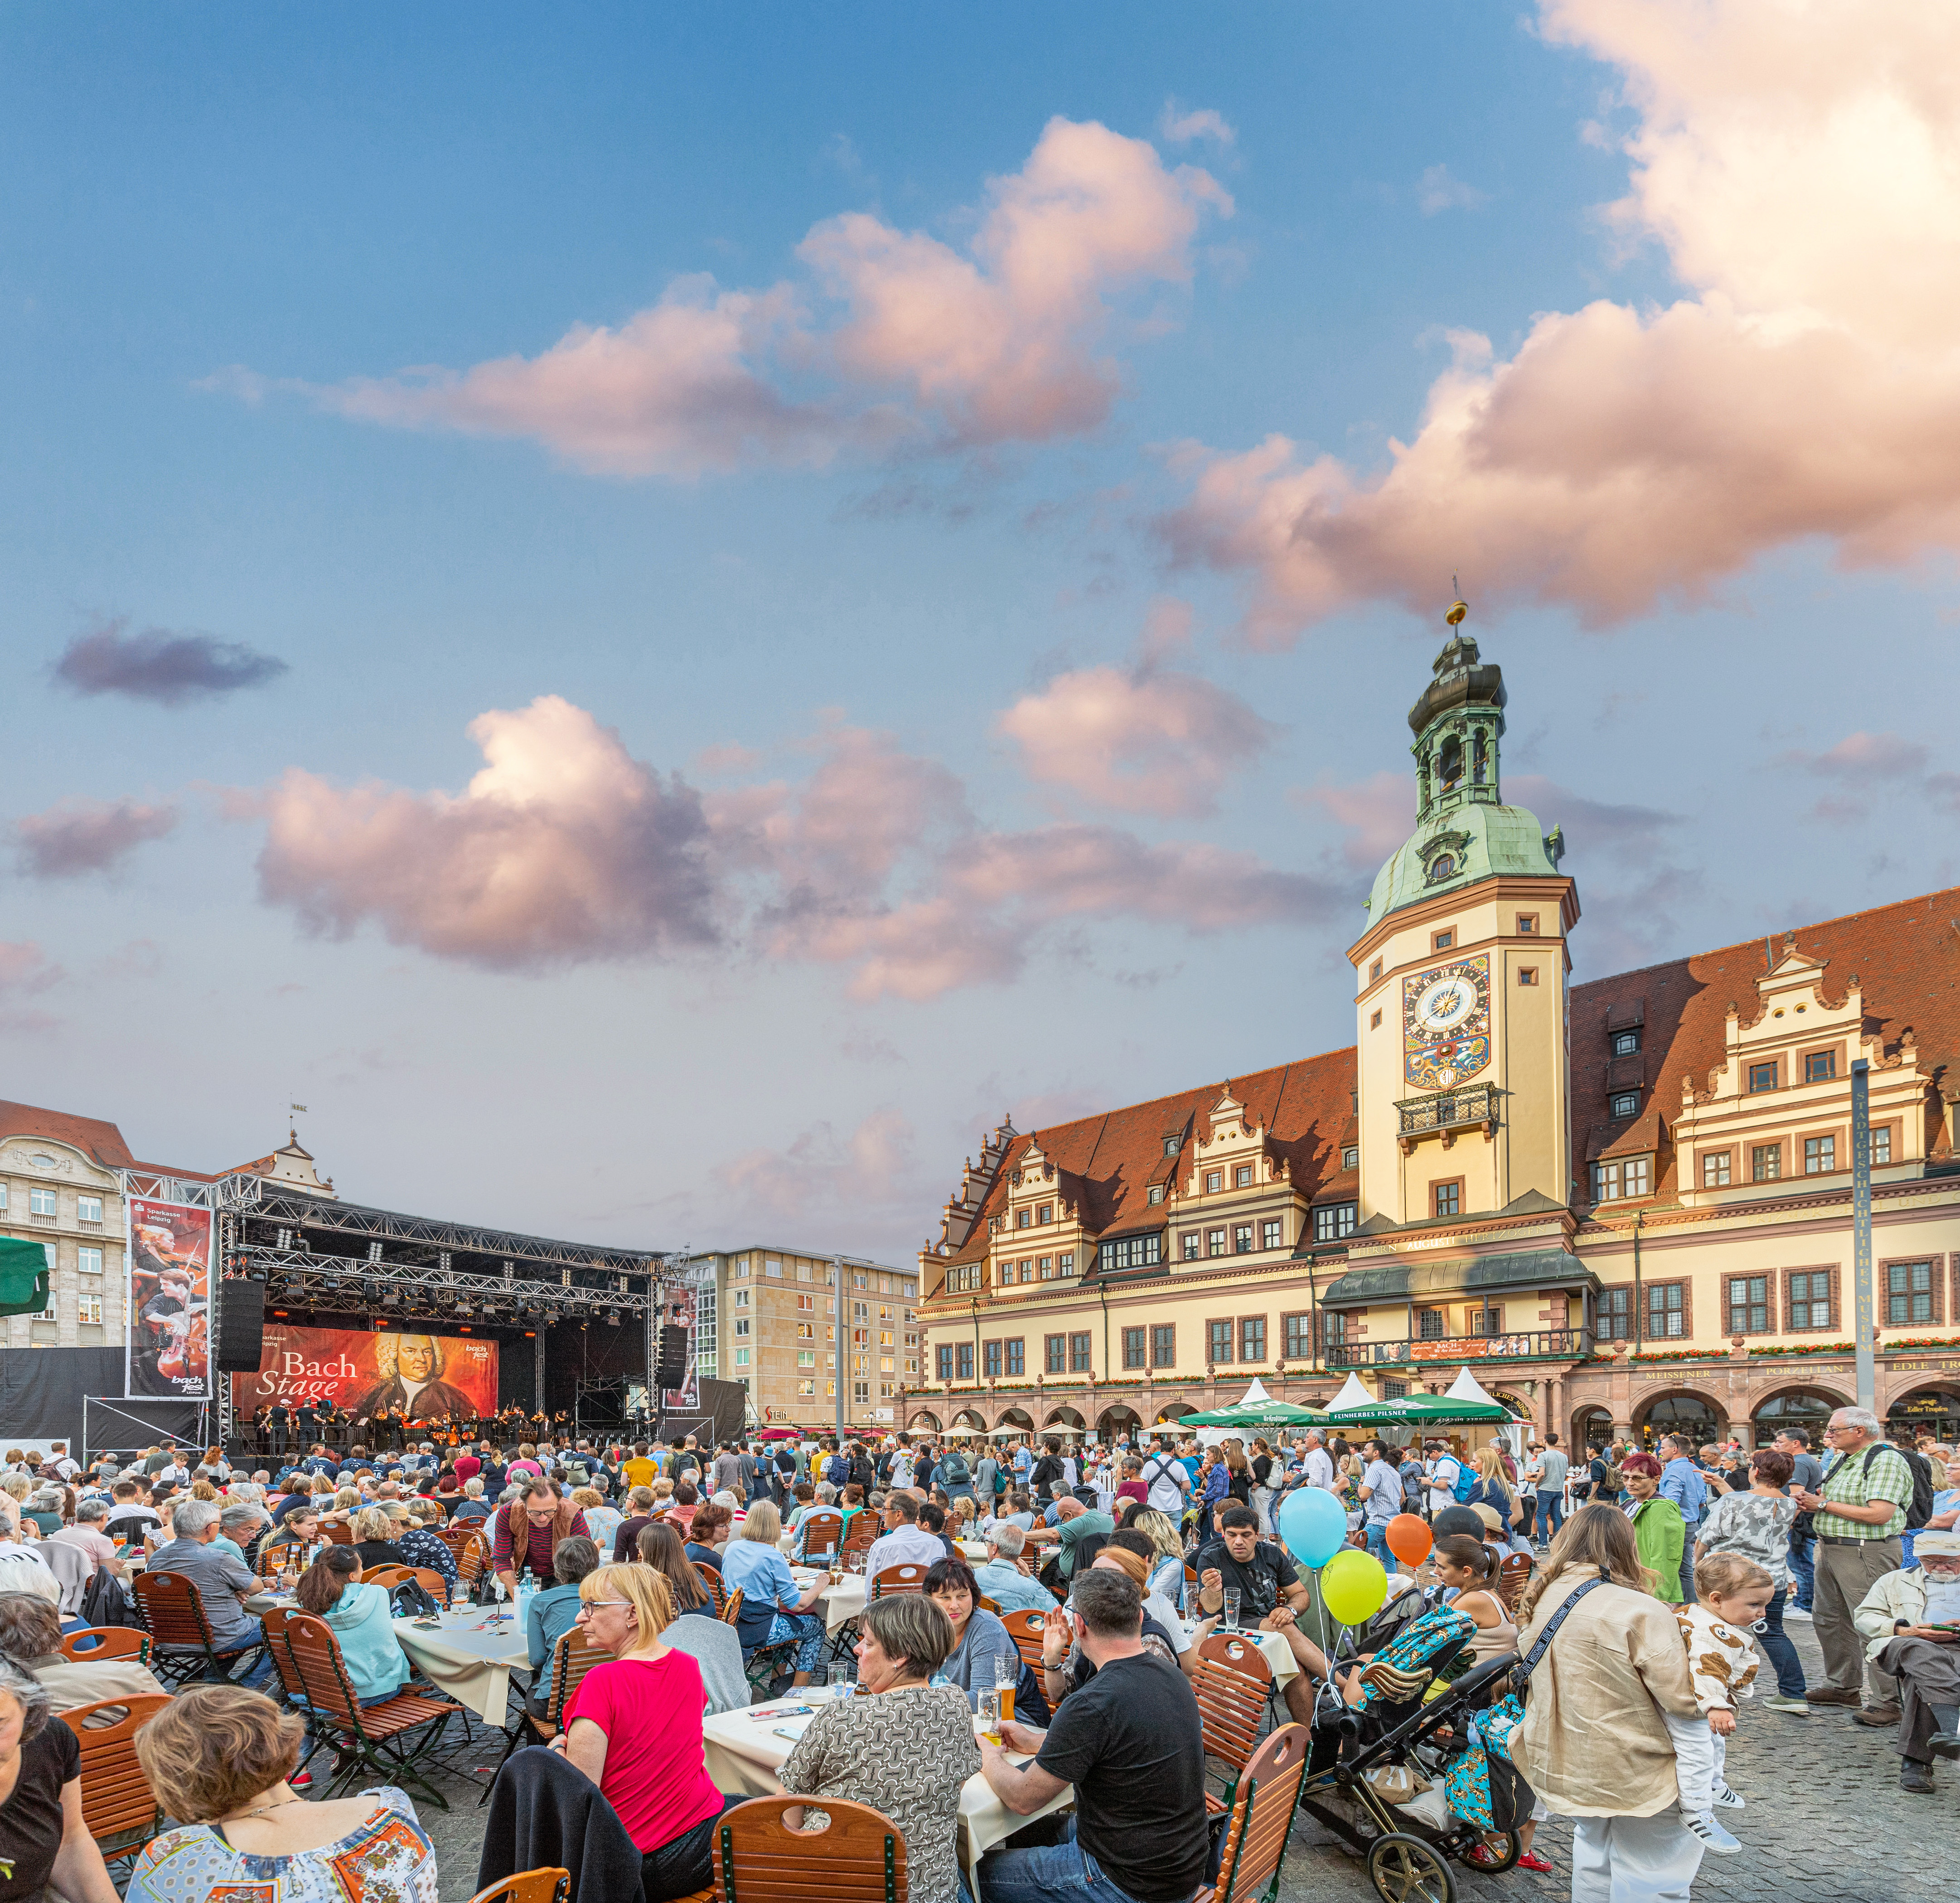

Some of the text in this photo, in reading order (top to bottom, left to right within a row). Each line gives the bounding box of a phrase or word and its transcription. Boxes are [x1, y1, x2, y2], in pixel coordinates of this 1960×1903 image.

[147, 1208, 181, 1217] Sparkasse
[147, 1215, 171, 1223] Leipzig
[1856, 1092, 1872, 1352] STADTGESCHICHTLICHES MUSEUM
[1005, 1302, 1030, 1310] GEBURTH
[1158, 1278, 1234, 1292] DURCHLAUCHTIGEN
[1238, 1268, 1316, 1283] HOCHGEBORENEN
[1358, 1244, 1397, 1256] HERRN
[1407, 1236, 1455, 1251] AUGUSTI
[1465, 1225, 1547, 1243] HERTZOGEN
[1583, 1233, 1607, 1243] DES
[1679, 1218, 1735, 1232] REICHS
[1898, 1194, 1941, 1207] UND
[282, 1352, 358, 1377] Bach
[1893, 1362, 1929, 1371] EDLE
[1646, 1370, 1711, 1379] MEISSENER
[1766, 1365, 1844, 1376] PORZELLAN
[171, 1376, 202, 1384] bach
[181, 1383, 205, 1393] fest
[256, 1370, 339, 1404] Stage
[1521, 1660, 1533, 1674] LOVE
[1528, 1641, 1545, 1664] MOSCHINO
[1541, 1629, 1553, 1642] LOVE
[1549, 1607, 1568, 1630] MOSCHINO
[1566, 1594, 1578, 1607] LOVE
